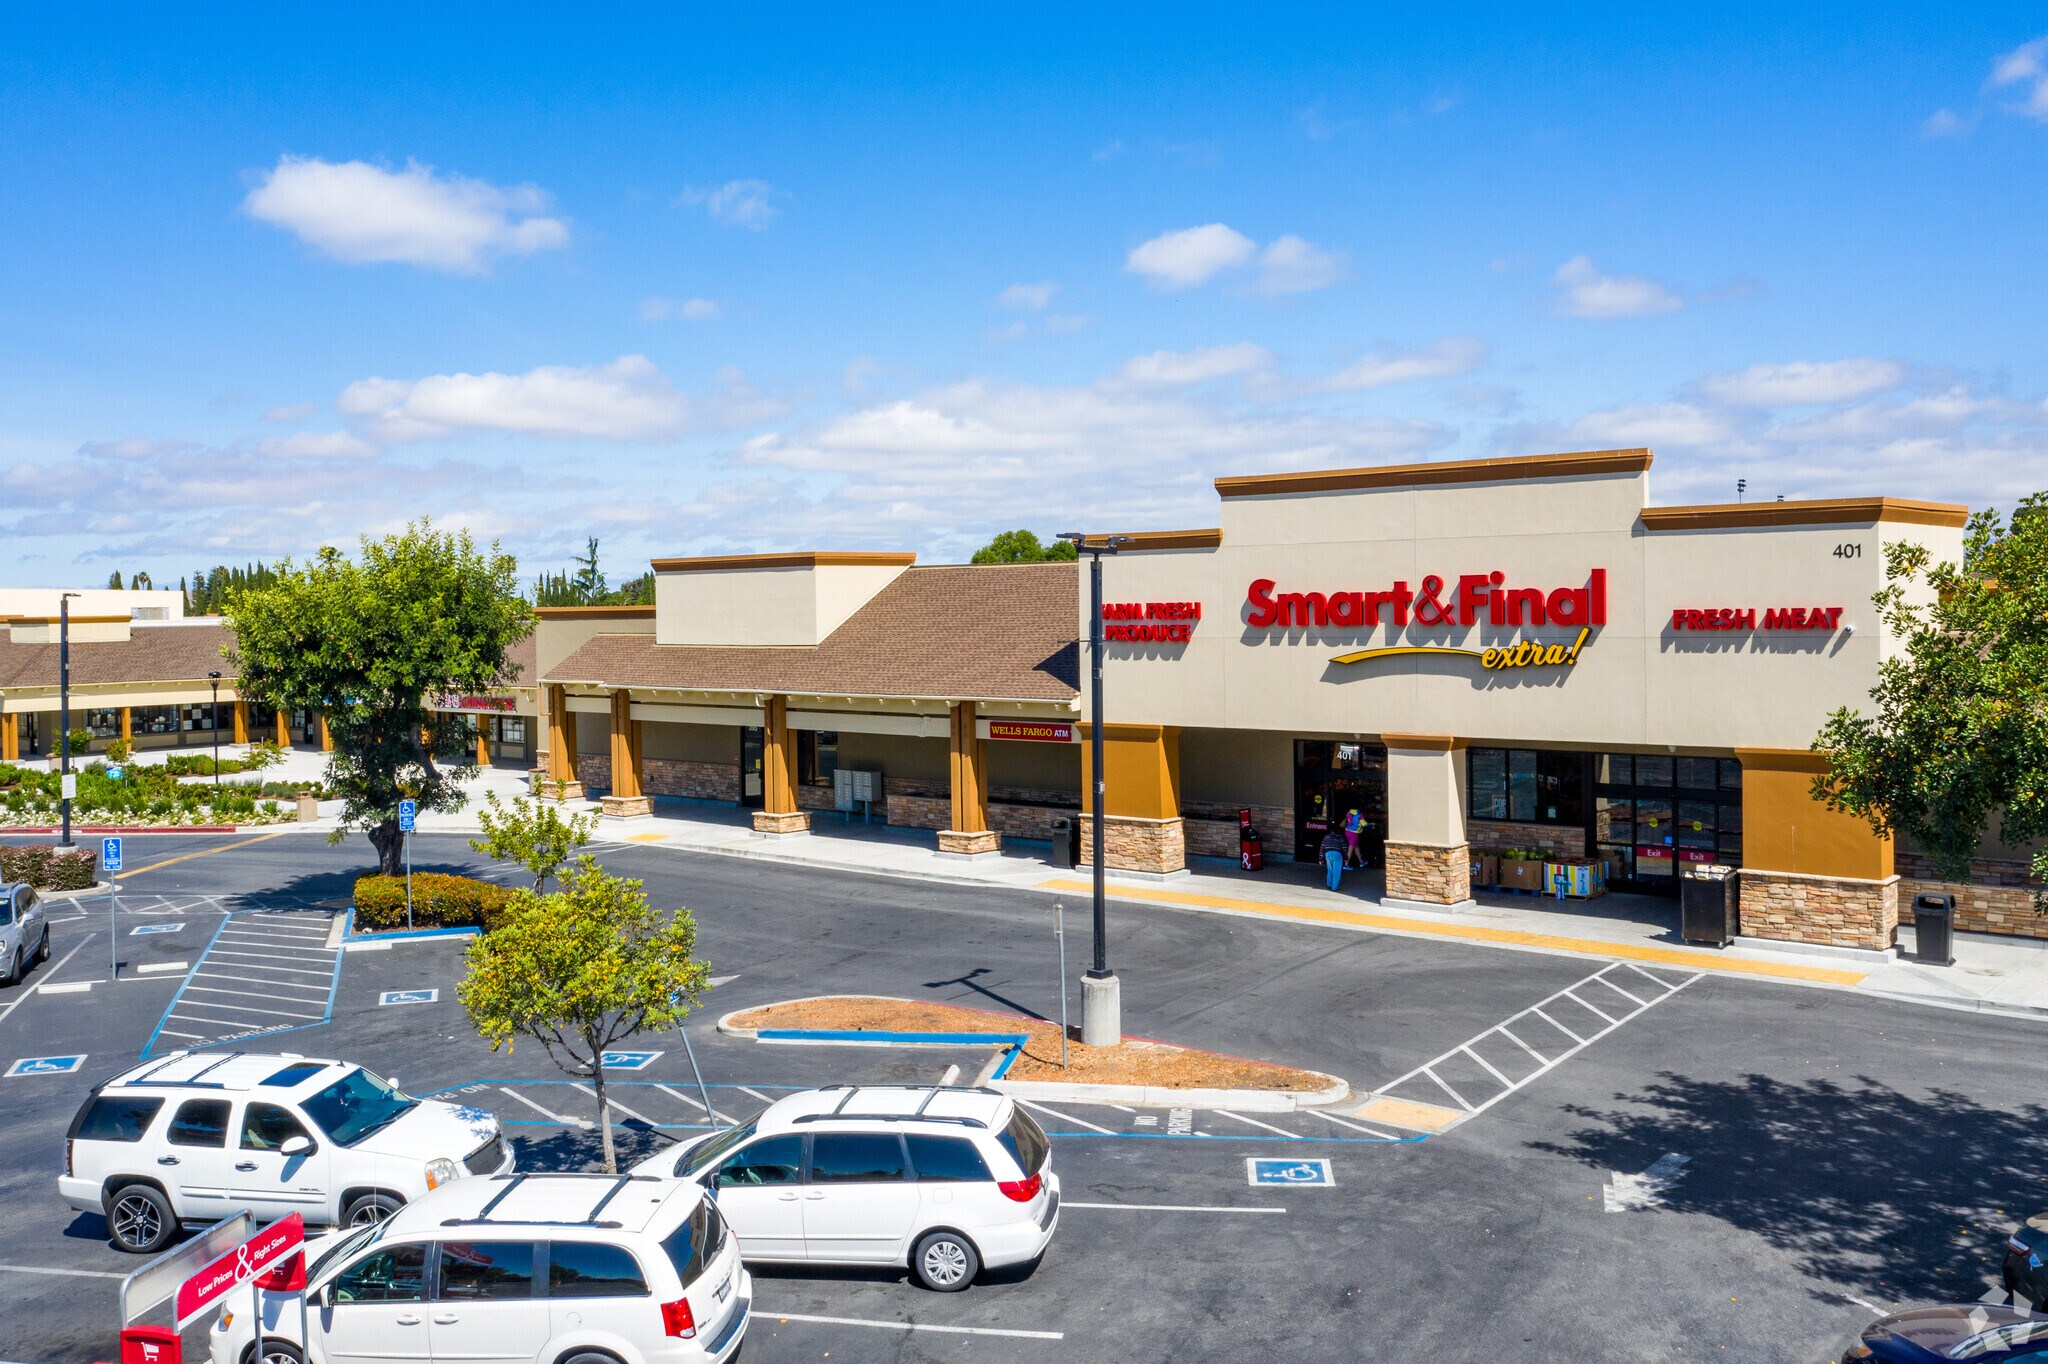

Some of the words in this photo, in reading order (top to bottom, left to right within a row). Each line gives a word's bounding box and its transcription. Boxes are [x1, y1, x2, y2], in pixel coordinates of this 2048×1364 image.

[1833, 543, 1861, 558] 401
[1145, 602, 1201, 620] FRESH
[1672, 608, 1756, 630] FRESH
[1763, 607, 1844, 630] MEAT
[1105, 624, 1191, 642] PRODUCE
[1481, 627, 1592, 669] extra!
[991, 726, 1021, 735] WELLS
[1022, 727, 1053, 737] FARGO
[1054, 729, 1069, 737] ATM
[1337, 751, 1352, 760] 401
[1647, 849, 1661, 857] Exit
[1690, 853, 1704, 861] Exit
[217, 1023, 294, 1041] PARKING
[460, 1083, 491, 1094] NO
[1134, 1115, 1158, 1126] NO
[1167, 1108, 1192, 1135] PARKING
[198, 1282, 213, 1297] Low
[213, 1269, 233, 1288] Prices
[254, 1244, 271, 1261] Right
[271, 1234, 287, 1250] Sizes
